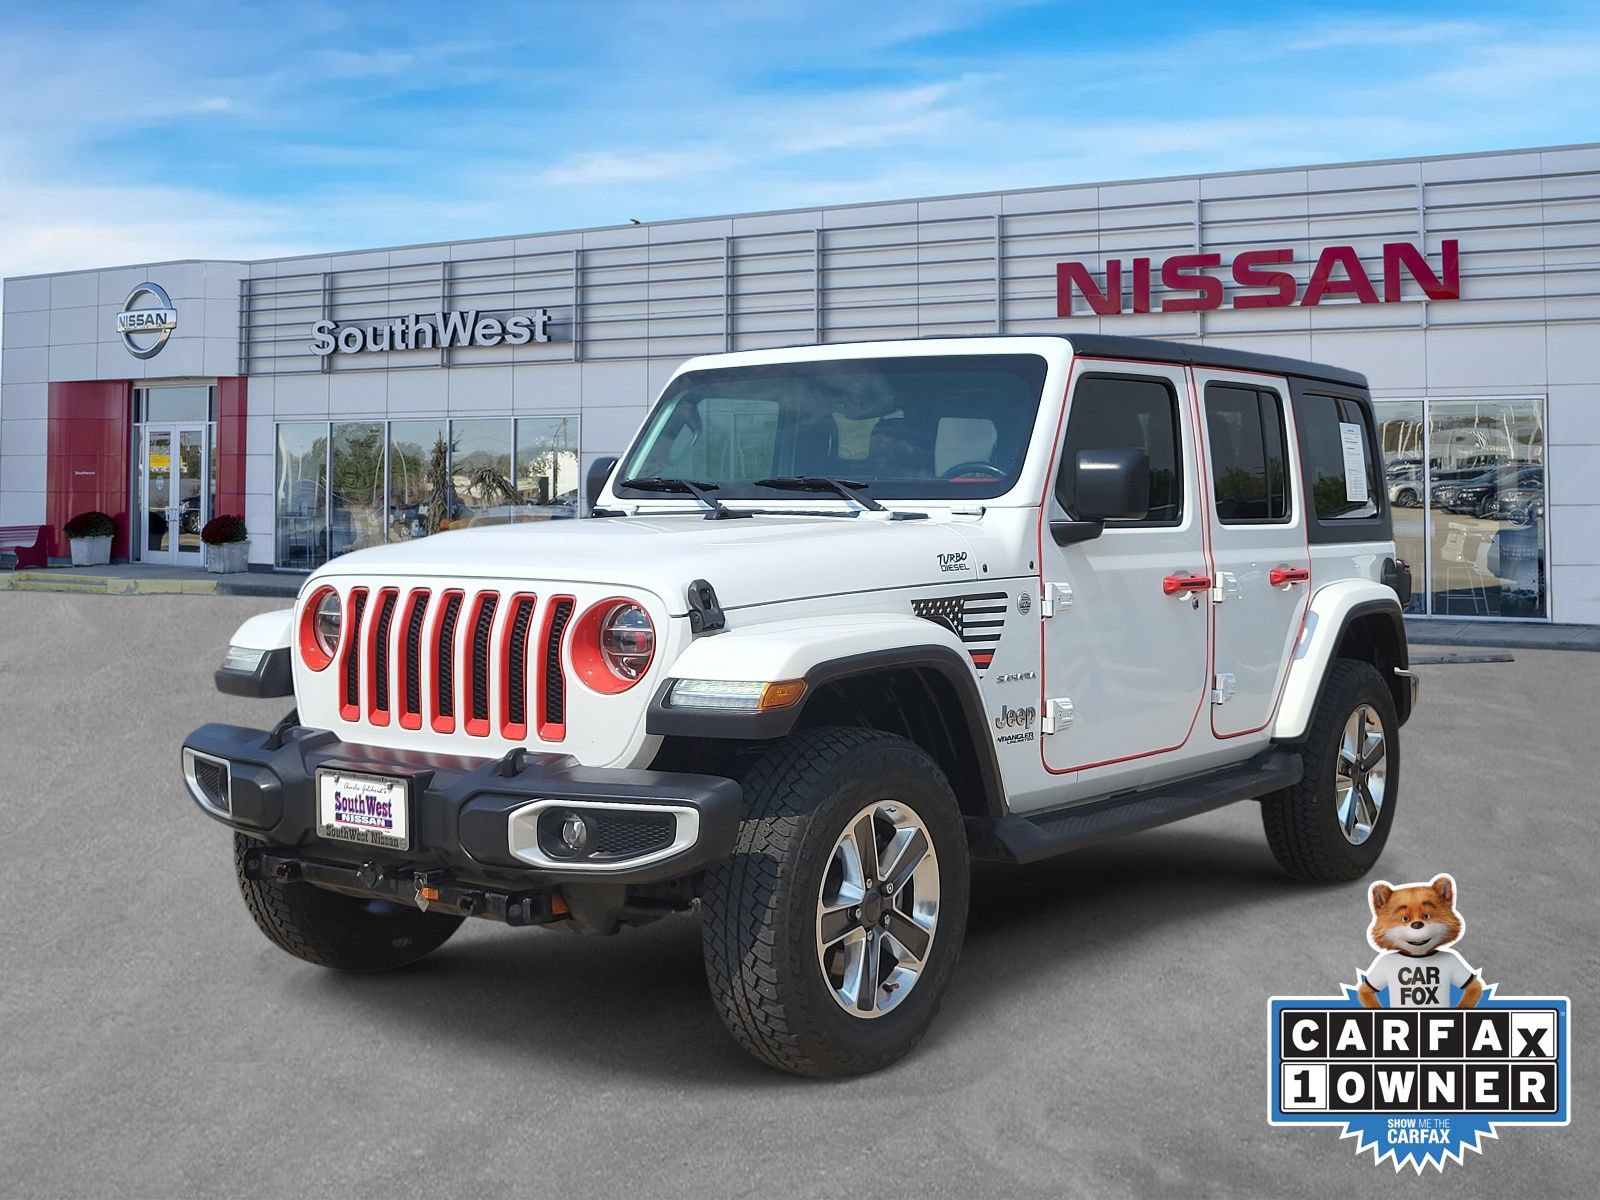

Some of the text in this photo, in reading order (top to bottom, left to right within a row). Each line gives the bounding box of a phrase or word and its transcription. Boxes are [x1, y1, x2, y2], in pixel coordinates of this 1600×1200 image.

[1056, 239, 1460, 318] NISSAN
[119, 312, 168, 328] NISSAN
[308, 308, 552, 356] SouthWest
[936, 551, 968, 566] TURBO
[940, 563, 970, 572] DIESEL
[995, 704, 1036, 730] Jeep
[998, 731, 1034, 743] WRANGLER
[334, 790, 393, 818] SouthWest
[341, 813, 386, 827] NISSAN
[325, 823, 399, 848] SouthWest Nissan
